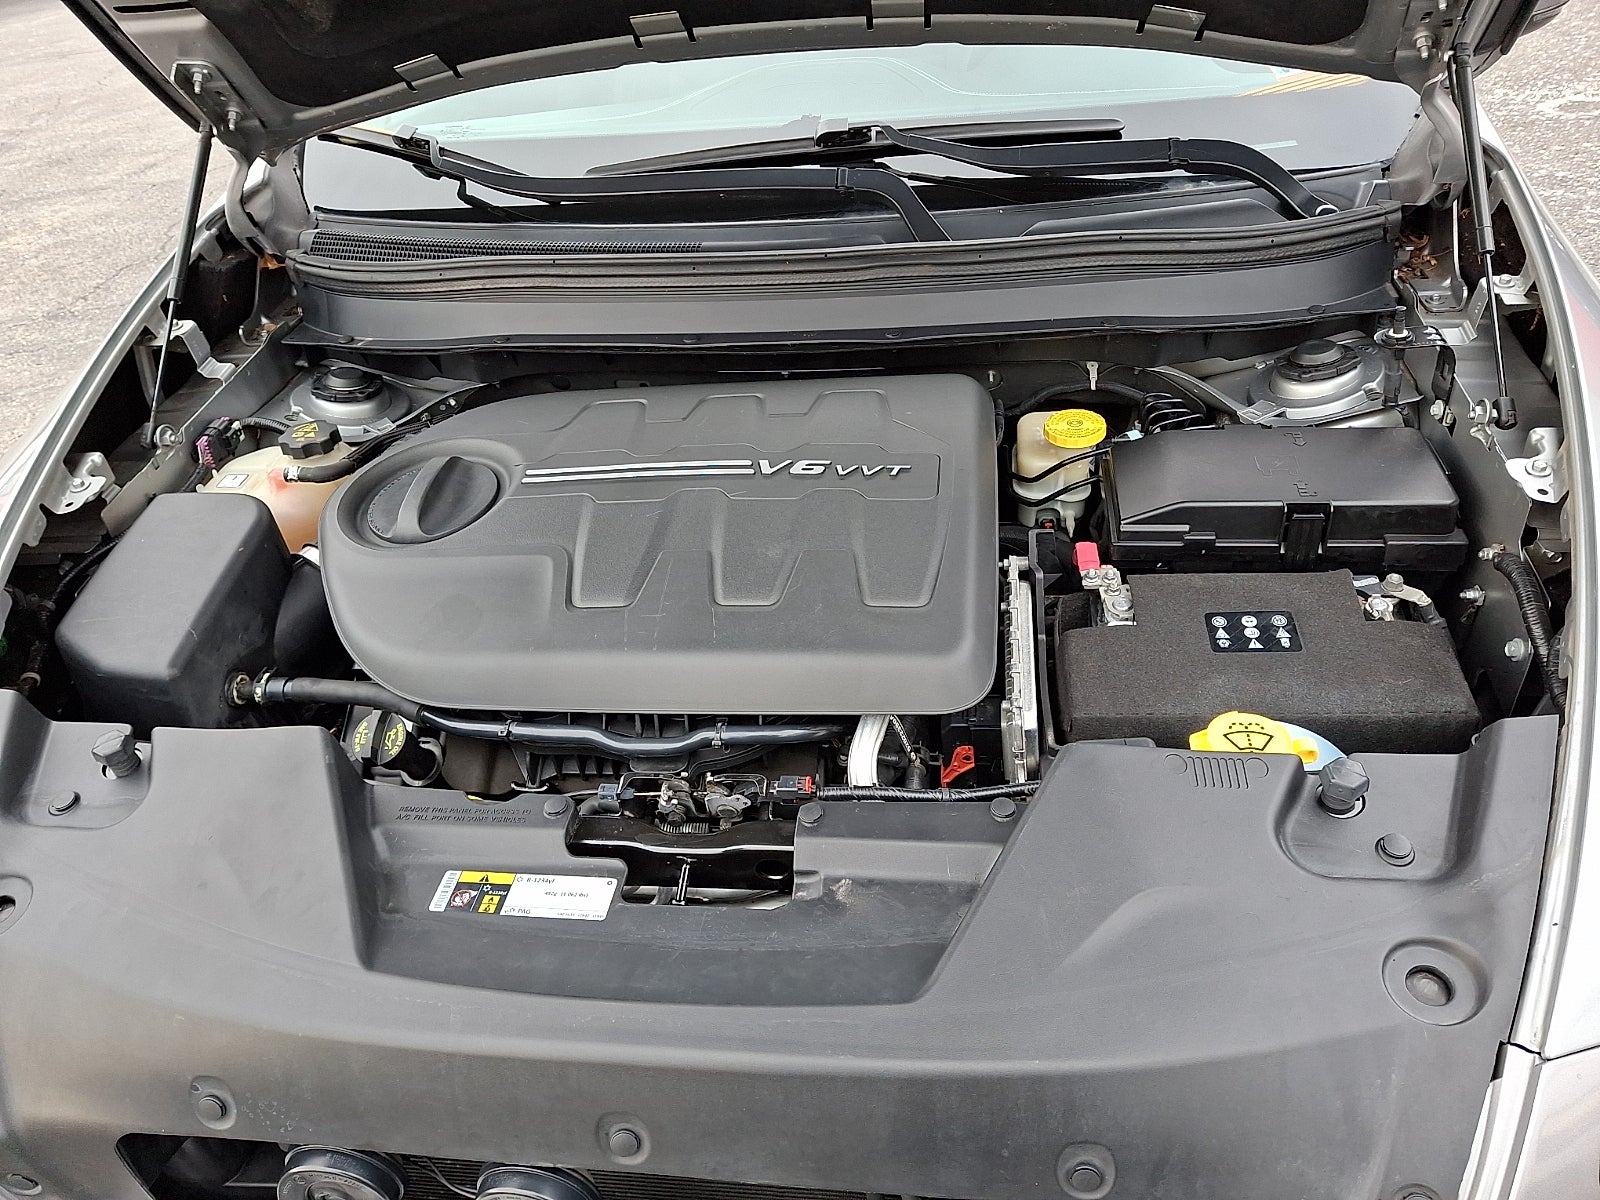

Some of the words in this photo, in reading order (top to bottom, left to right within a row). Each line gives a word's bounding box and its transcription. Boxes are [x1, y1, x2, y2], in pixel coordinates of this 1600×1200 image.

[758, 459, 832, 475] V6
[835, 464, 912, 477] VVT
[396, 722, 404, 746] ENGINE
[388, 746, 399, 756] OIL
[526, 877, 556, 885] R-1234yf
